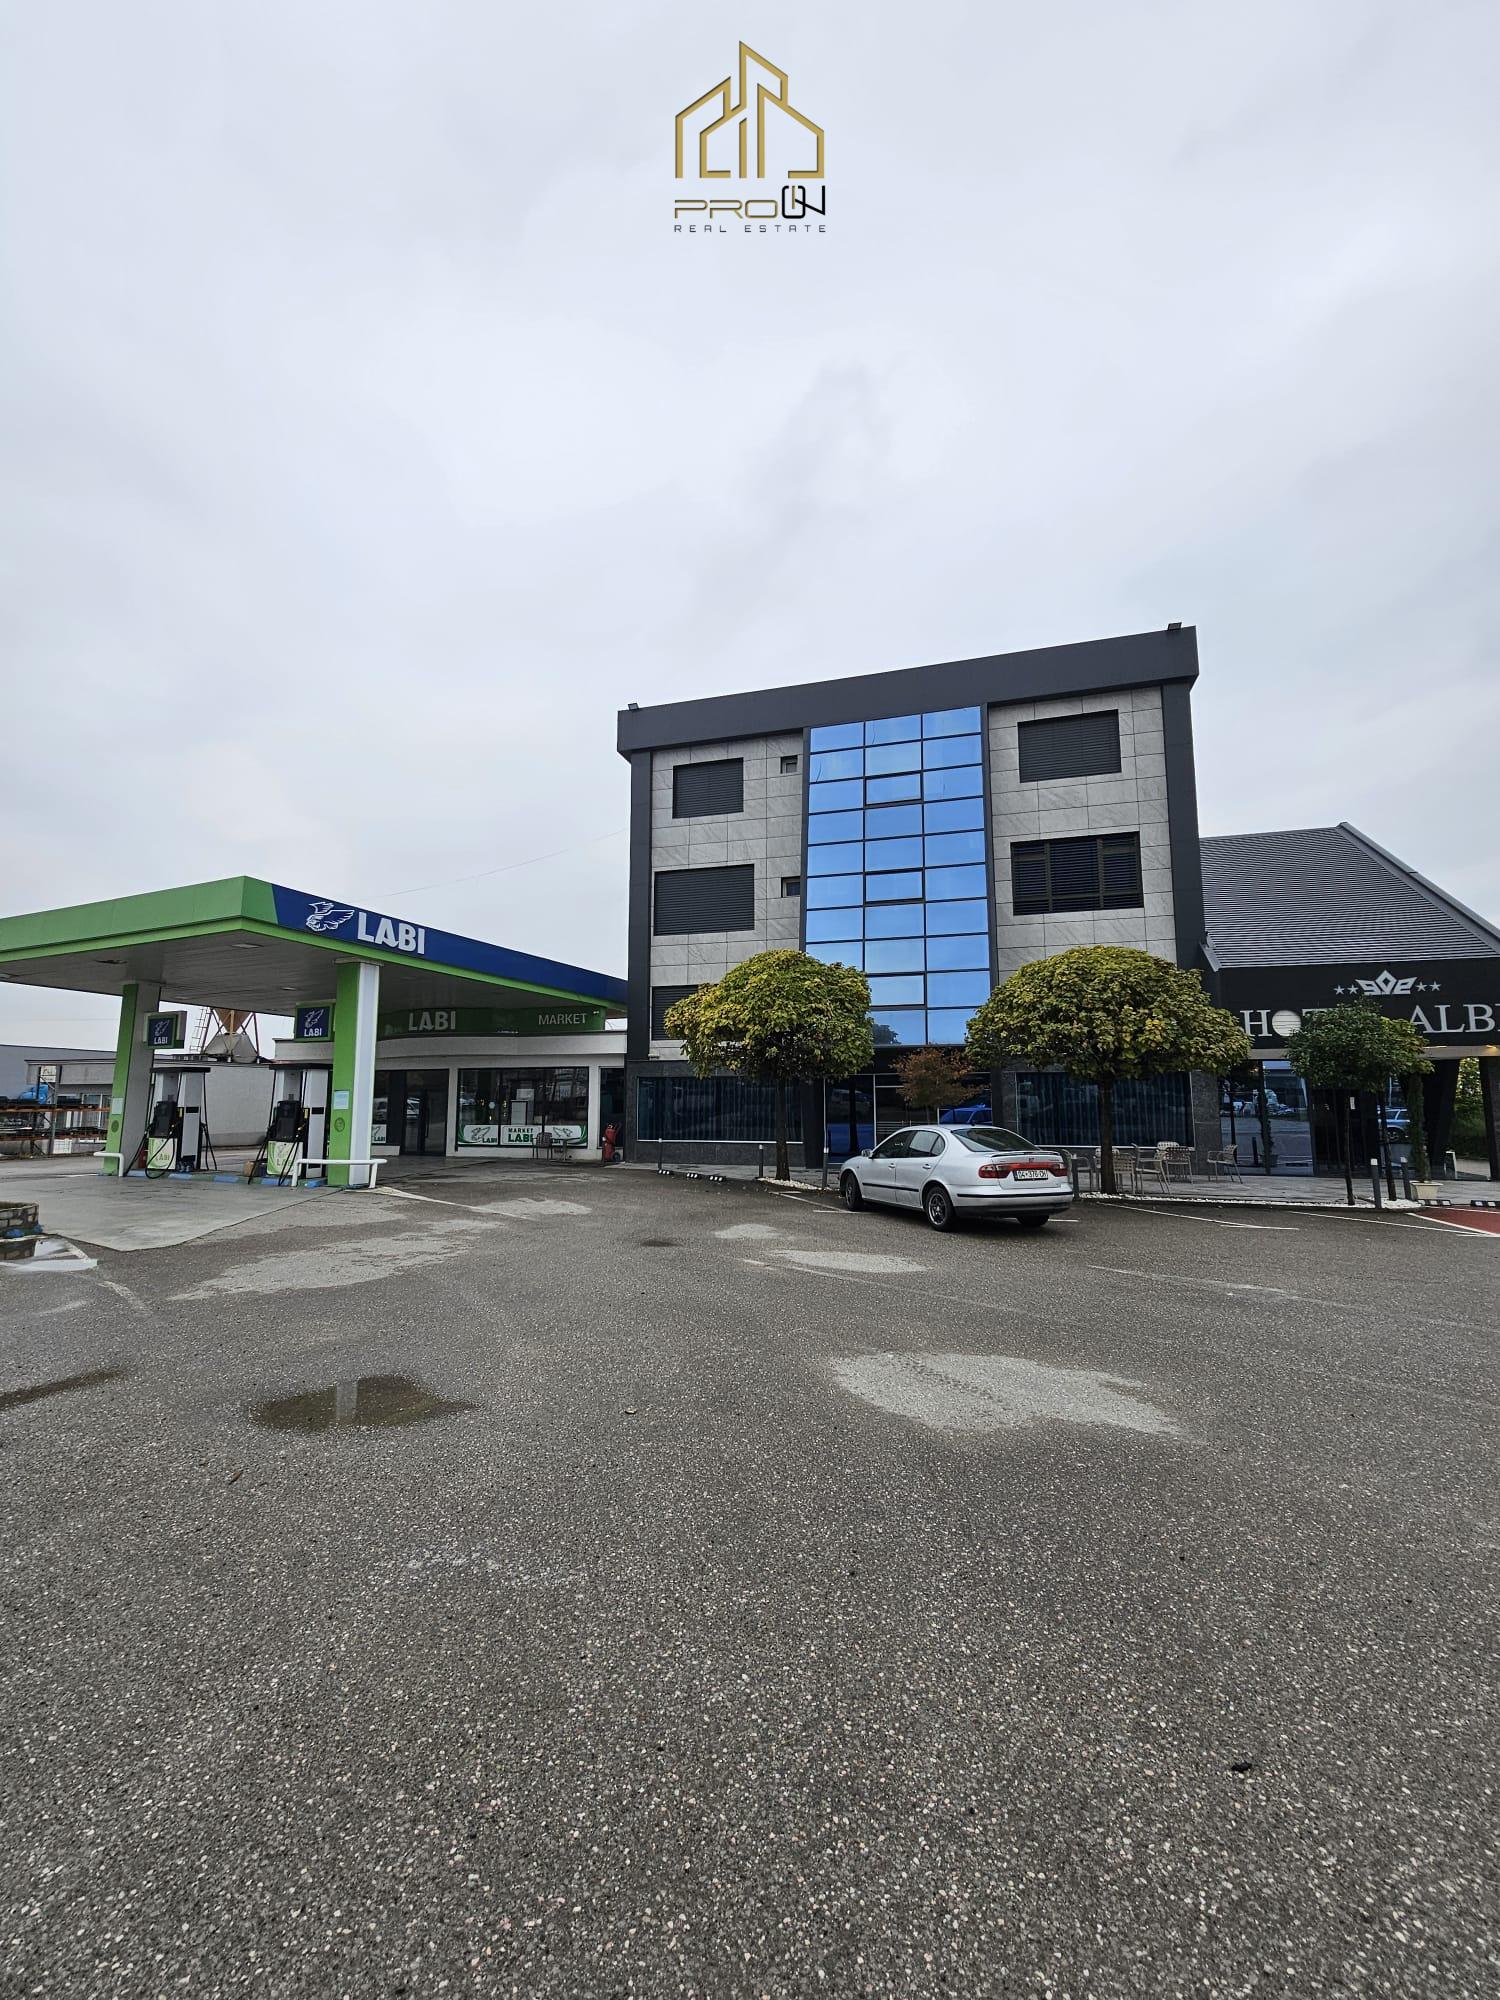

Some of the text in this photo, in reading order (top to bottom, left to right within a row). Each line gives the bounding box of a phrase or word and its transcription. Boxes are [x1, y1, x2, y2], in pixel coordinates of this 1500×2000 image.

[357, 911, 426, 955] LABI
[408, 1011, 457, 1032] LABI
[538, 1013, 588, 1025] MARKET
[303, 1028, 322, 1037] LABI
[153, 1036, 168, 1045] LABI
